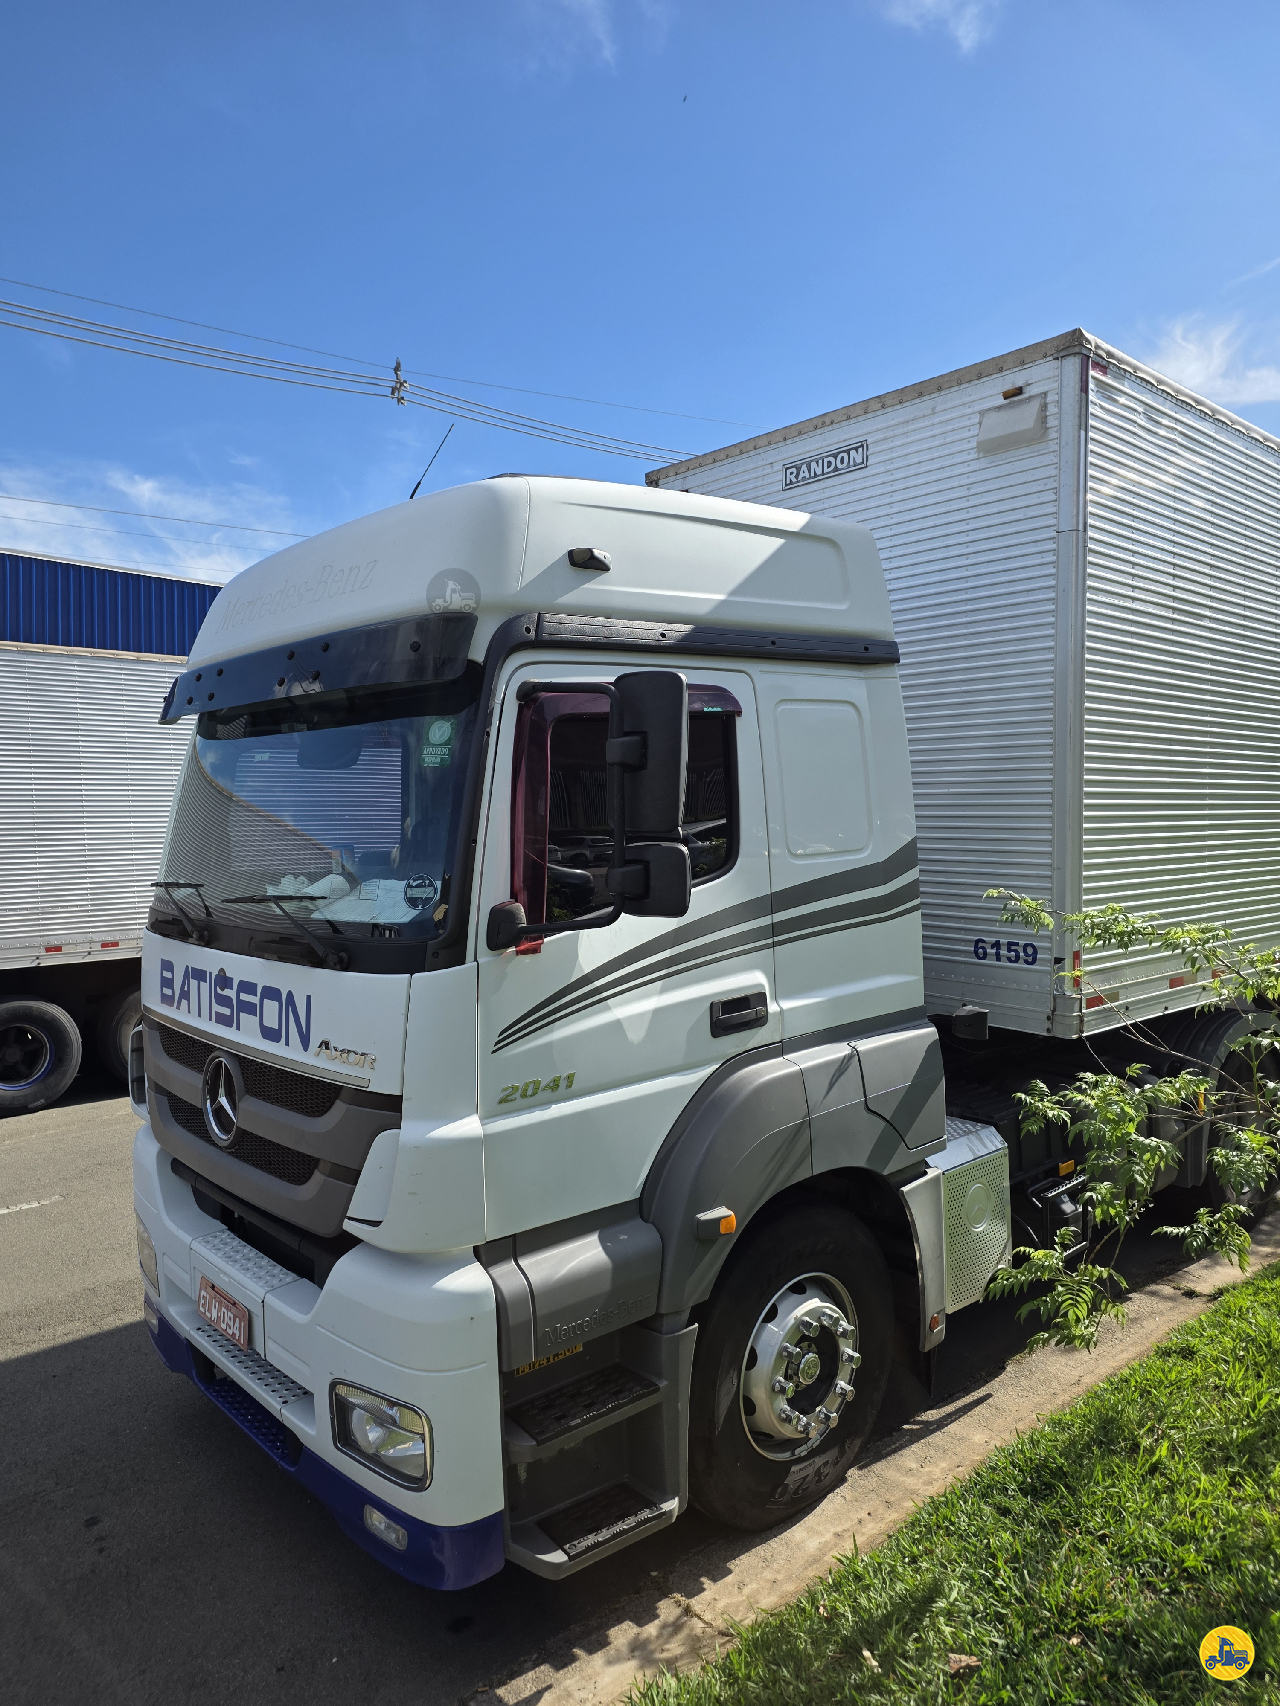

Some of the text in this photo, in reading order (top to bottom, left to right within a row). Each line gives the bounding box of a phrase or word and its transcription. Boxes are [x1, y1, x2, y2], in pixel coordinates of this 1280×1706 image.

[786, 447, 863, 485] RANDON
[214, 559, 379, 634] Mercedes-Benz
[973, 938, 1038, 966] 6159
[160, 957, 312, 1053] BATISFON
[497, 1070, 577, 1105] 2041
[544, 1294, 652, 1347] Mercedes-Benz
